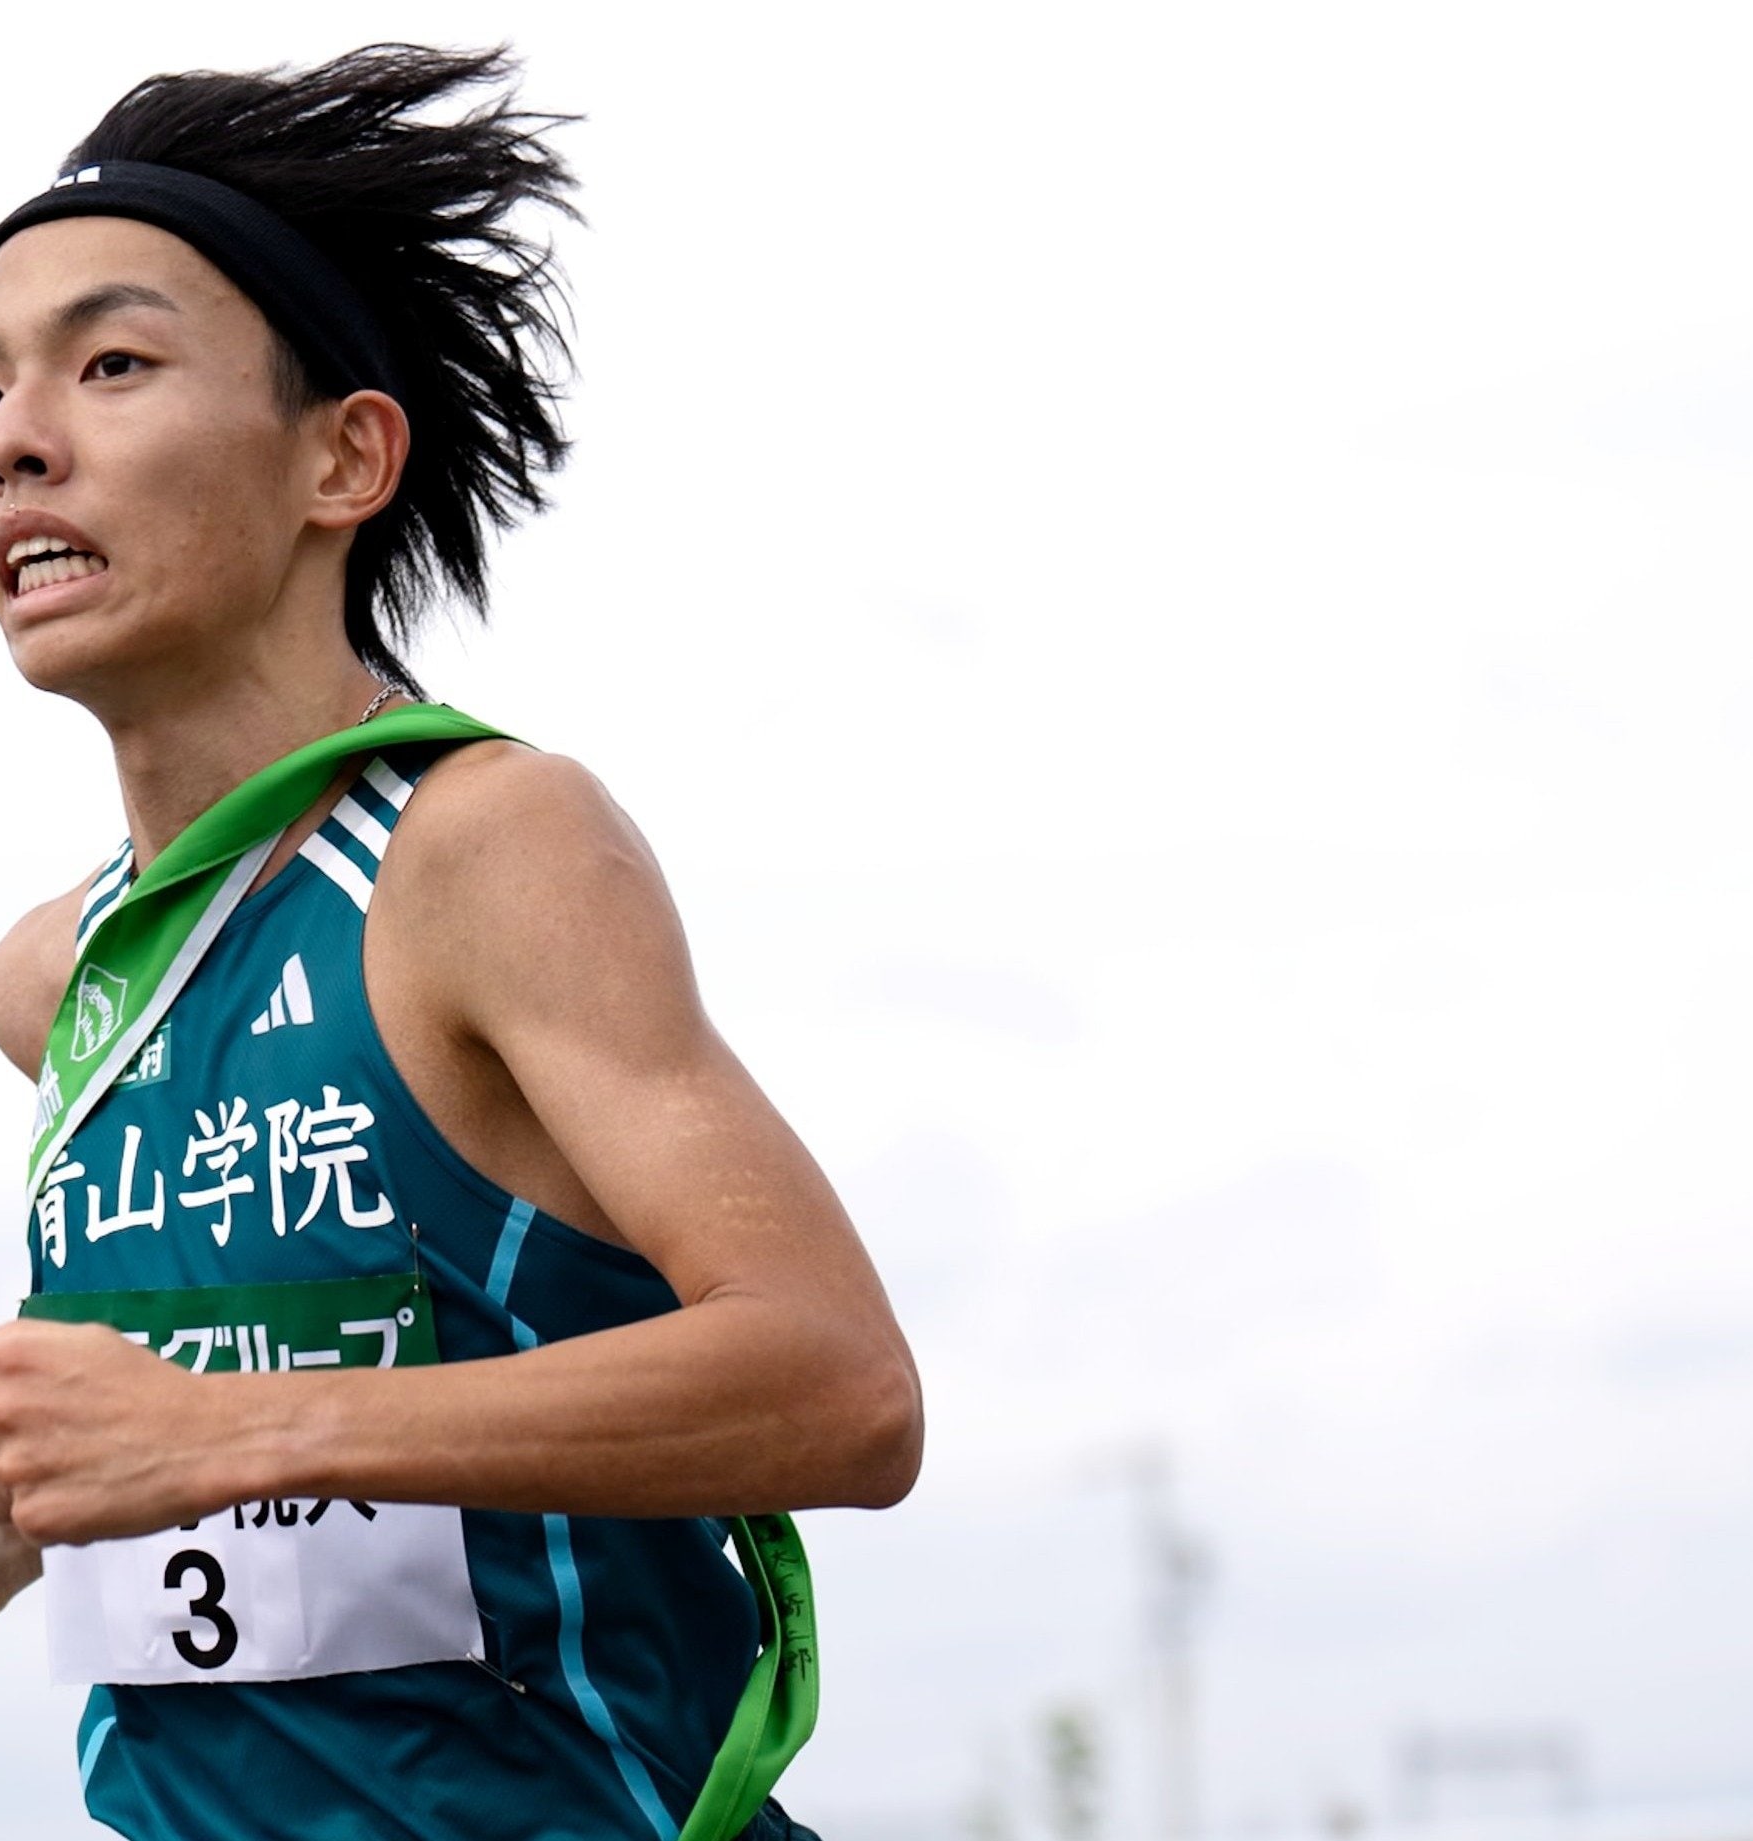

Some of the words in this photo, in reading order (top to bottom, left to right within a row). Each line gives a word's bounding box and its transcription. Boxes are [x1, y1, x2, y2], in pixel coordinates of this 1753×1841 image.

[121, 1308, 414, 1375] グループ
[164, 1549, 239, 1669] 3
